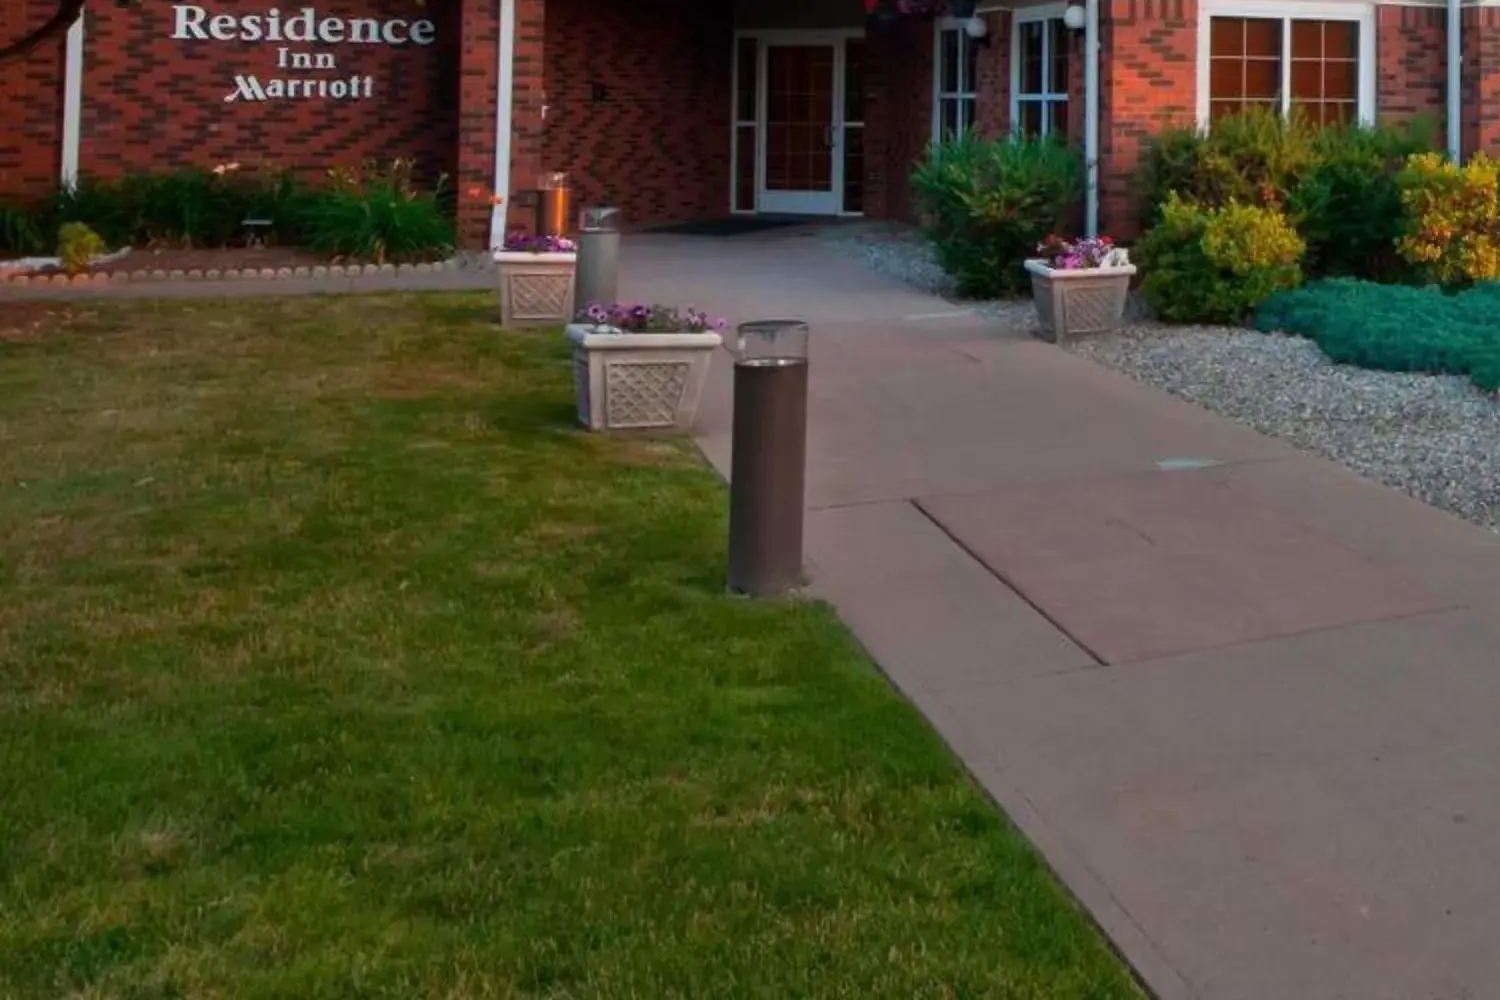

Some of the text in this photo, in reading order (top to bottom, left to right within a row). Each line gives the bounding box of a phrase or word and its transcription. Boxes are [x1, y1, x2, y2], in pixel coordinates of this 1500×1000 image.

[171, 4, 435, 44] Residence
[277, 47, 336, 69] Inn
[223, 74, 374, 101] Marriott
